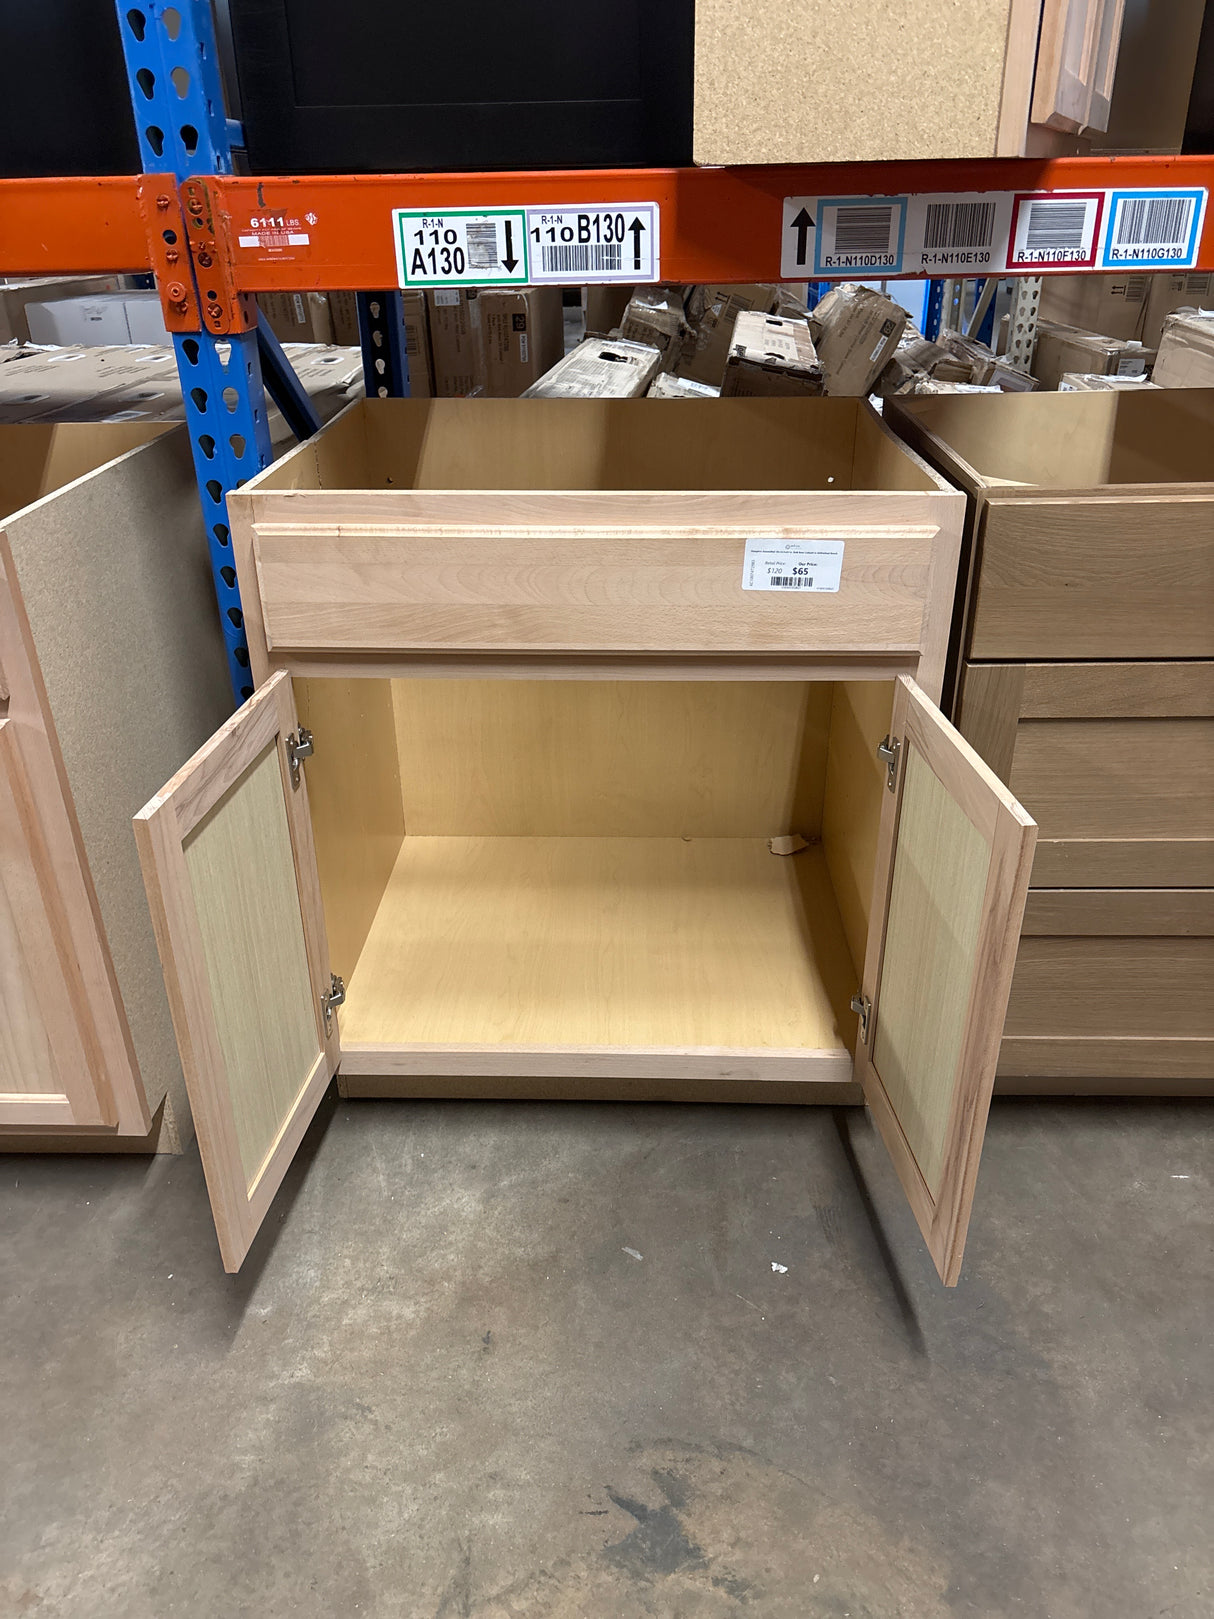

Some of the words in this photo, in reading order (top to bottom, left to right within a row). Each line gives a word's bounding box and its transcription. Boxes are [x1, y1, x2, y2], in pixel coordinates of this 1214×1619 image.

[250, 216, 285, 228] 6111
[422, 218, 444, 229] R-1-N
[541, 215, 563, 225] R-1-N
[530, 226, 574, 243] 110
[577, 213, 625, 243] B130
[413, 229, 458, 246] 110
[920, 252, 991, 265] R-1-N110E130
[1017, 249, 1087, 263] R-1-N110F130
[1111, 248, 1183, 260] R-1-N110G130
[411, 246, 465, 276] A130
[825, 254, 895, 267] R-1-N110D130
[767, 567, 783, 575] $120
[792, 567, 809, 576] $65
